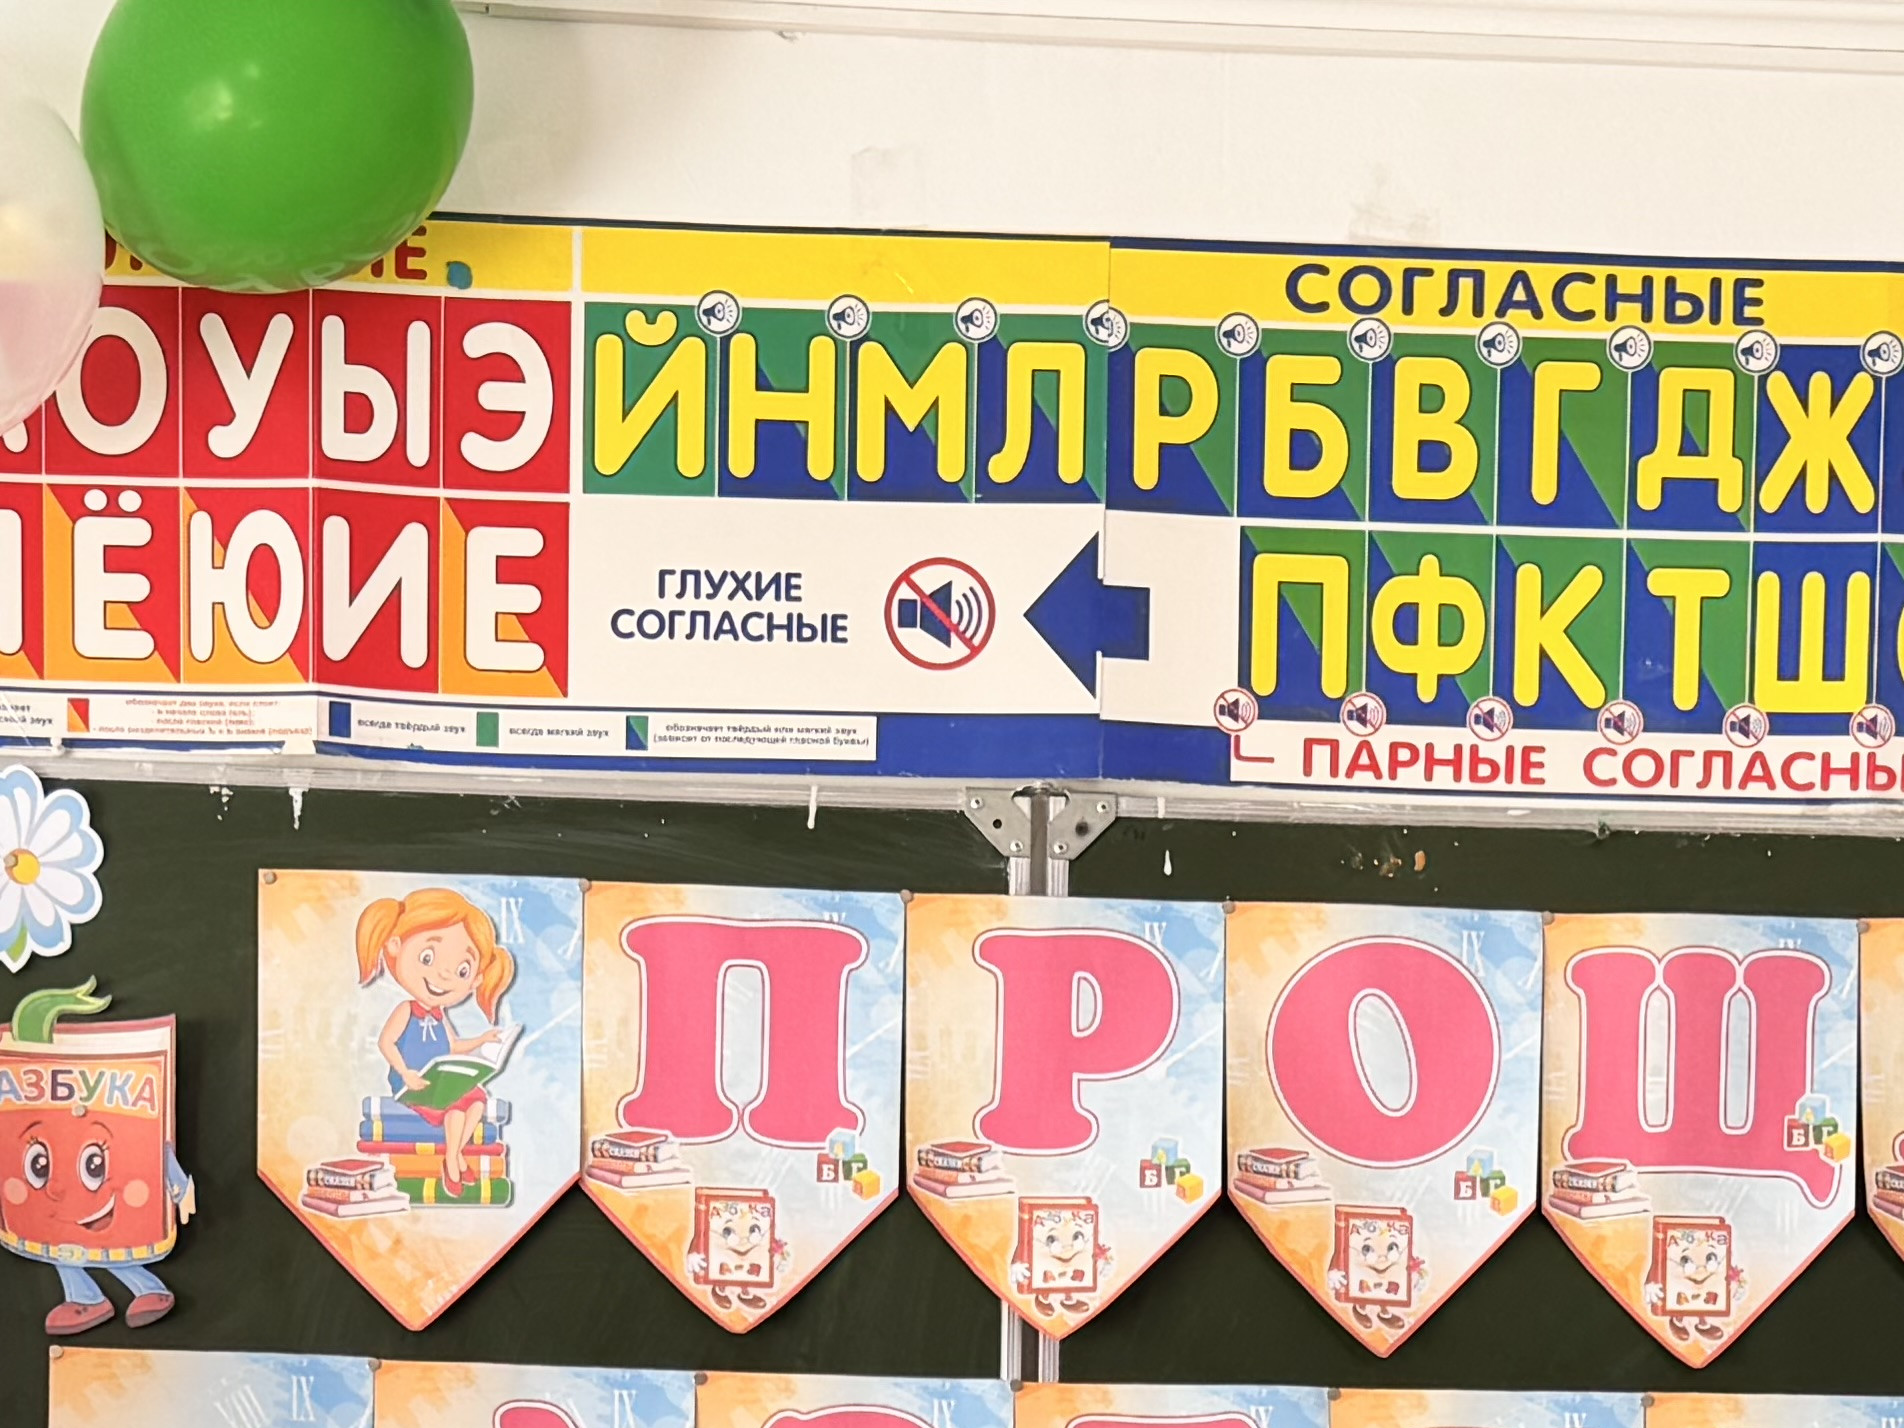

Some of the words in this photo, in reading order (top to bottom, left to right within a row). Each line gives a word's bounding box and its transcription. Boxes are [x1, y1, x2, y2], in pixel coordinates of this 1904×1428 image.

[1285, 262, 1765, 329] СОГЛАСНЫЕ
[657, 568, 803, 604] ГЛУХИЕ
[611, 607, 849, 645] СОГЛАСНЫЕ
[1301, 736, 1547, 787] ПАРНЫЕ
